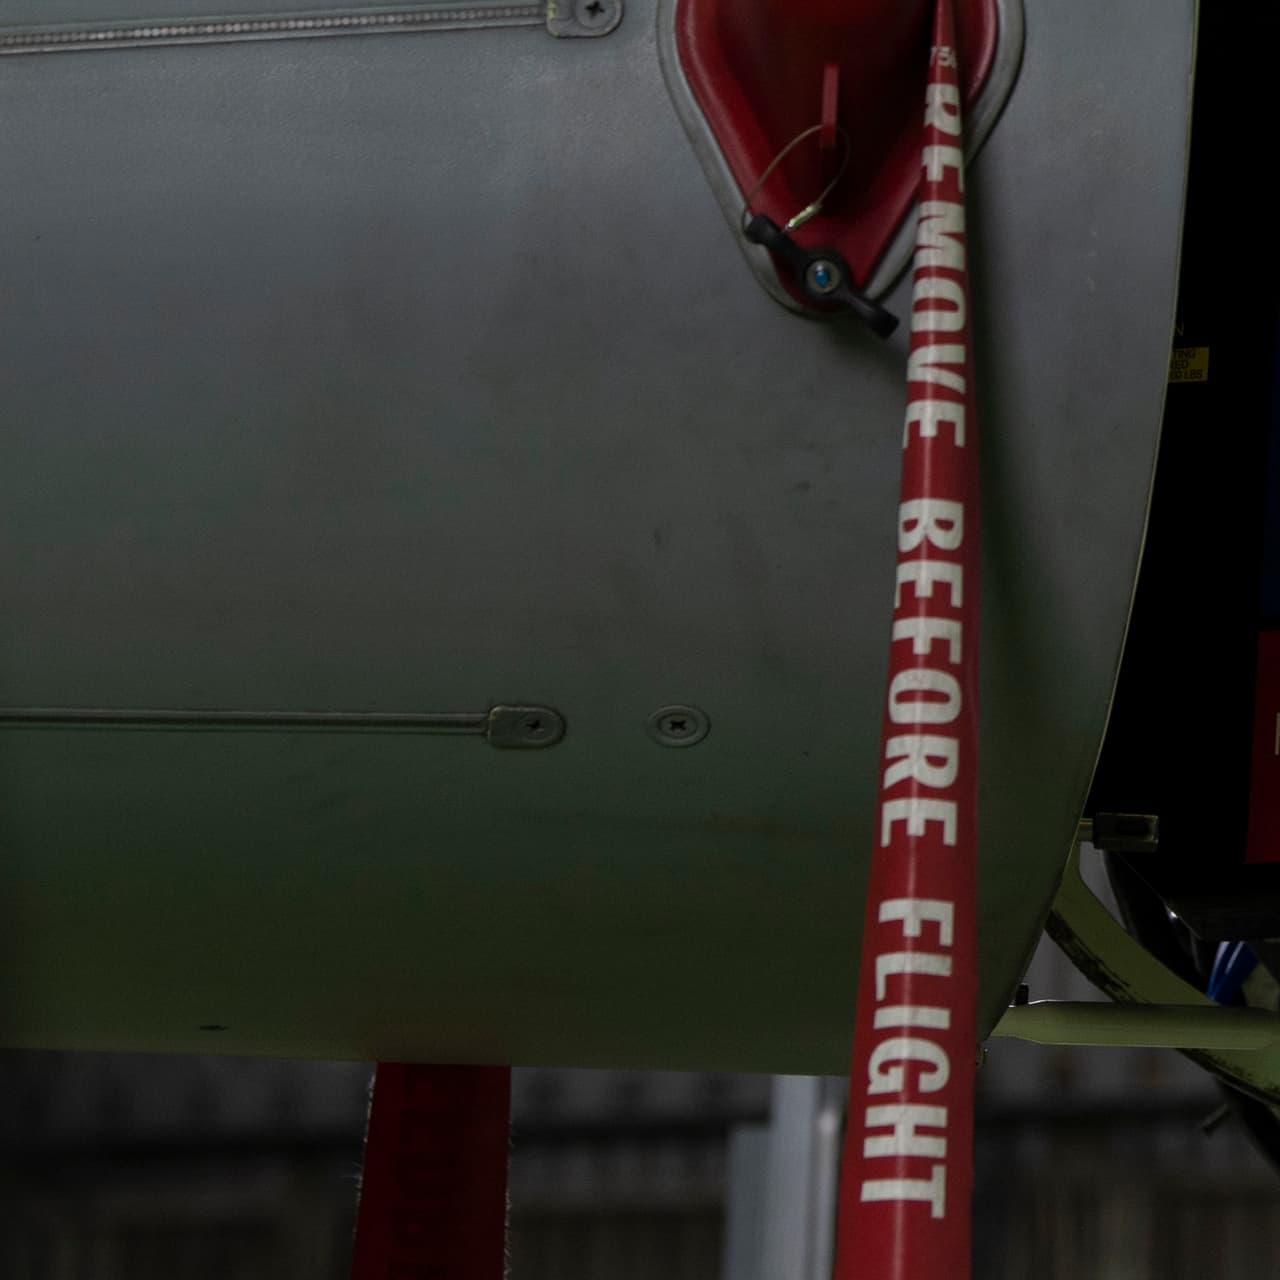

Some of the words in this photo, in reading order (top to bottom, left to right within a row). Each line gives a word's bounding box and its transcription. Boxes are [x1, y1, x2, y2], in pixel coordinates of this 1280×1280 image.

[903, 83, 965, 449] REMOVE
[881, 497, 963, 846] BEFORE
[861, 897, 953, 1218] FLIGHT
